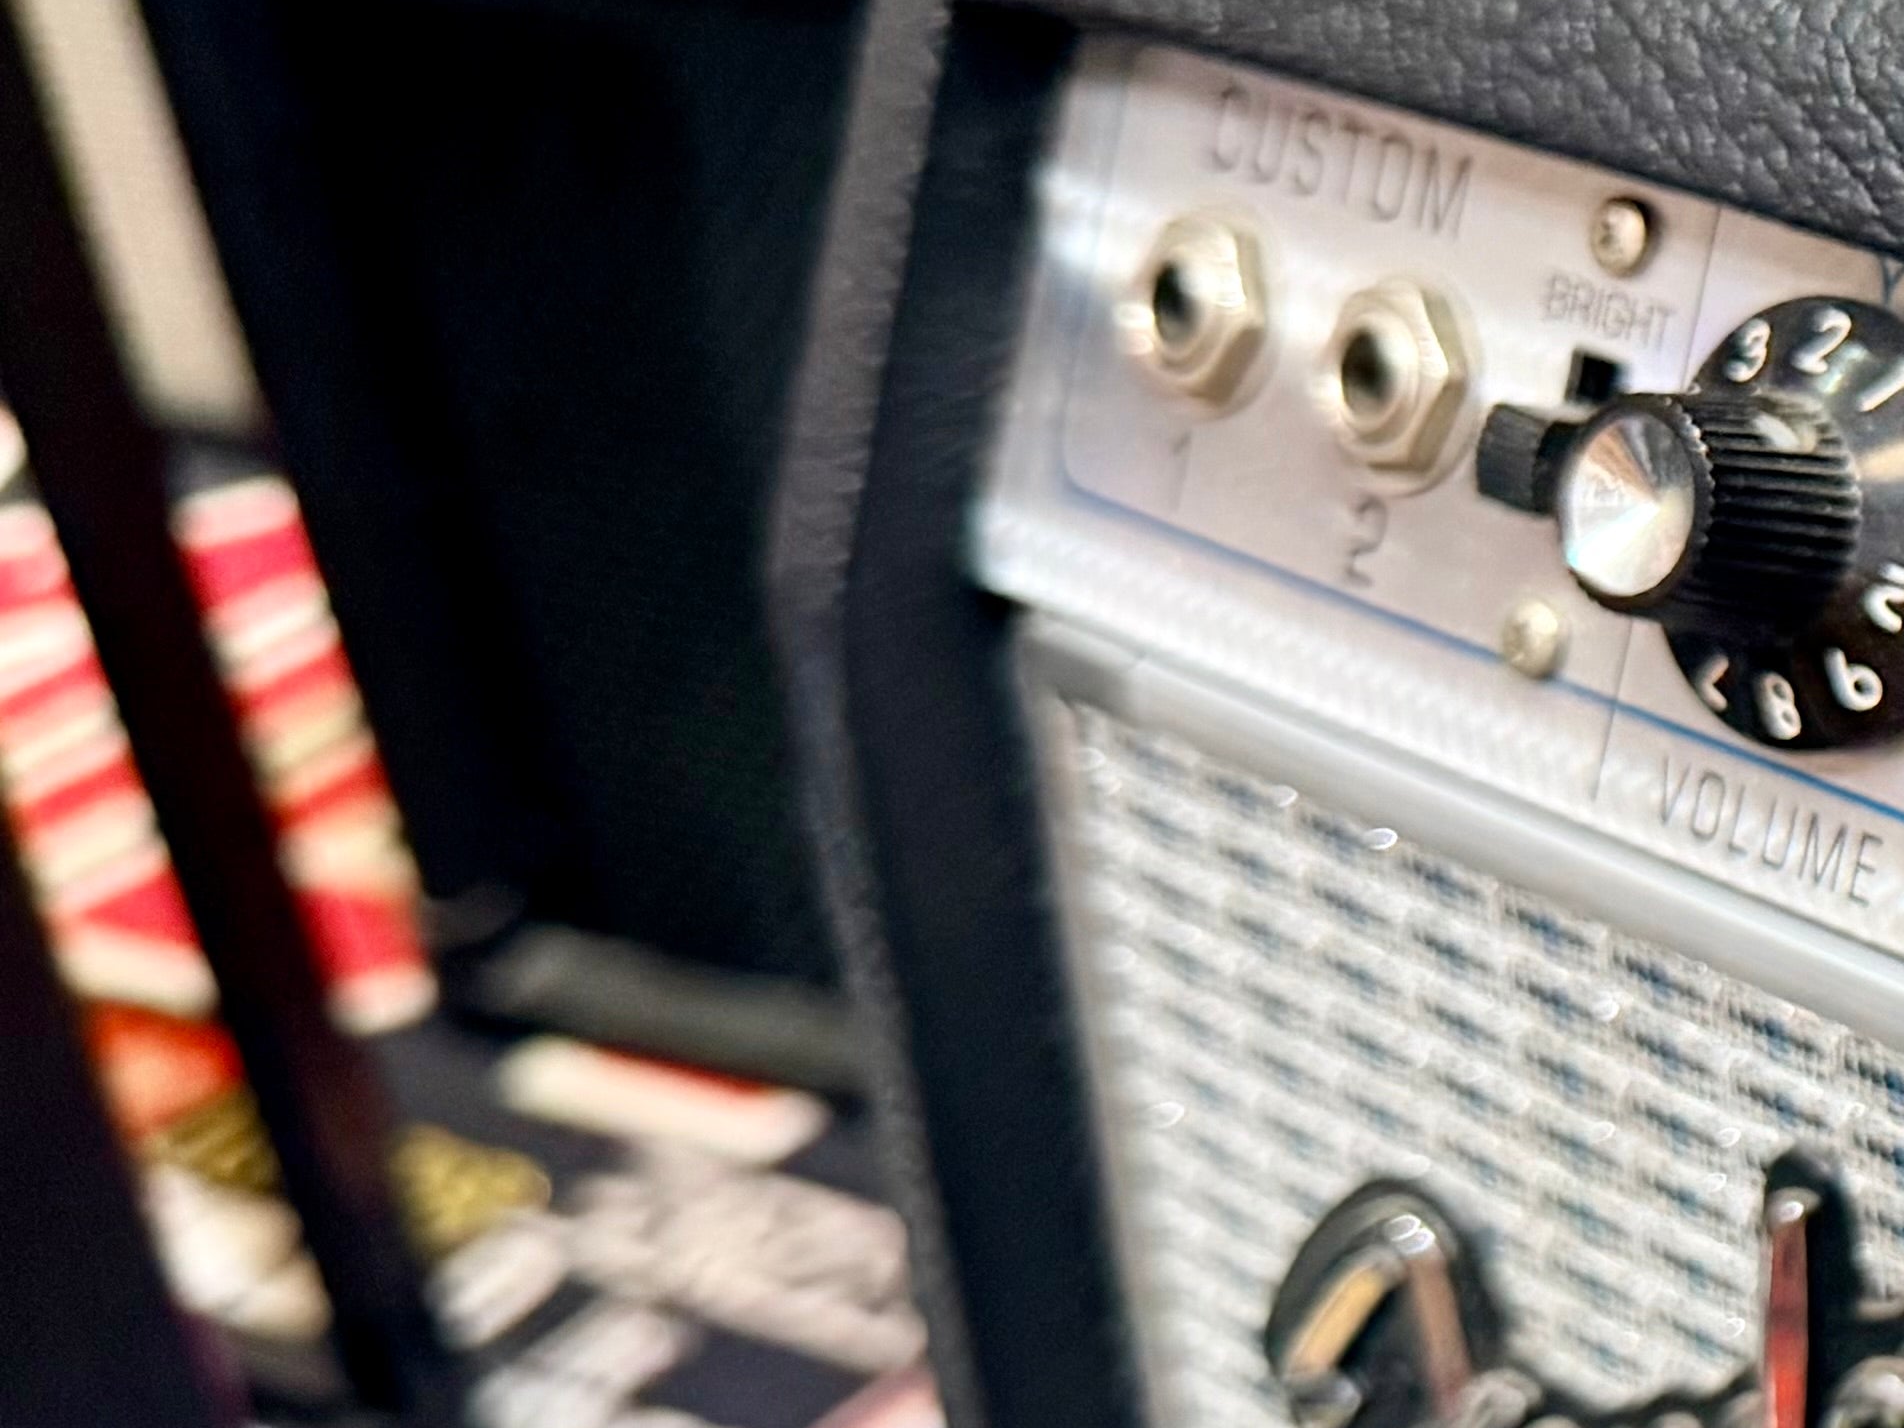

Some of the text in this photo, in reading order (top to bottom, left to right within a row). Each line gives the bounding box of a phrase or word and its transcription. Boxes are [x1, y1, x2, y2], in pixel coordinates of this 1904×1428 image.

[1209, 83, 1474, 240] CUSTOM
[1542, 271, 1677, 351] BRIGHT
[1724, 318, 1771, 382] 3
[1793, 307, 1852, 373] 2
[1341, 492, 1389, 588] 2
[1753, 672, 1801, 740] 8
[1659, 755, 1884, 909] VOLUME
